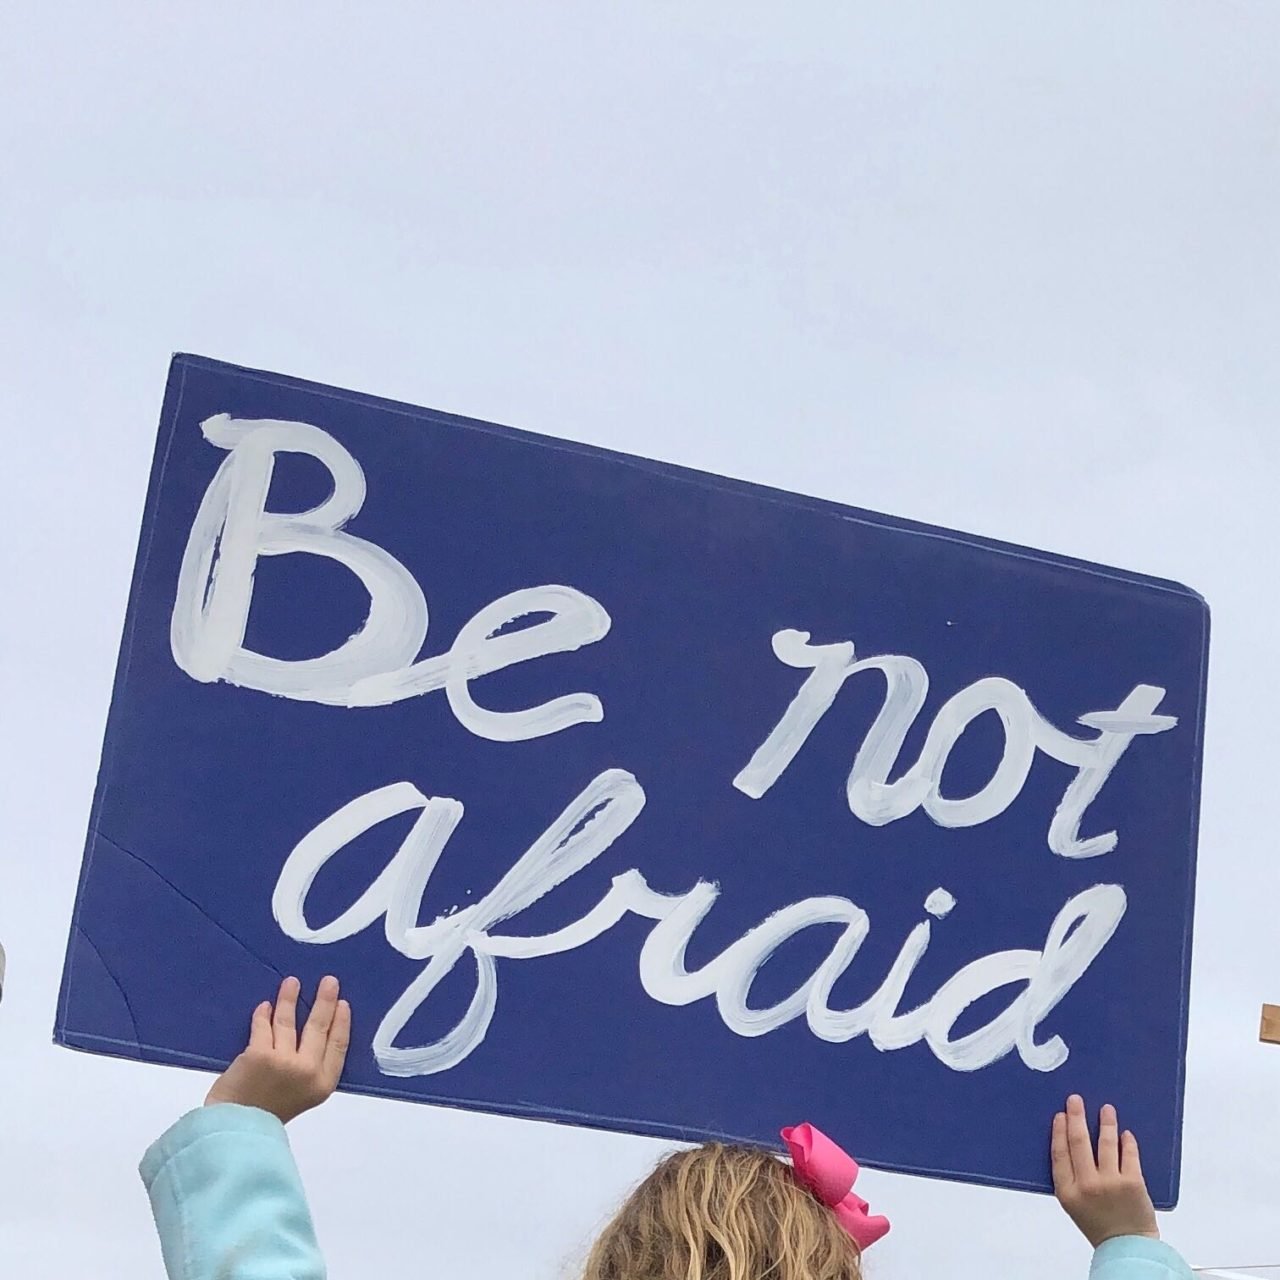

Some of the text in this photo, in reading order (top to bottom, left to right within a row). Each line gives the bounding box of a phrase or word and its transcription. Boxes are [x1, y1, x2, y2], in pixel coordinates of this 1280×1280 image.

[170, 412, 1178, 859] Be not
[271, 769, 1127, 1078] afraid
